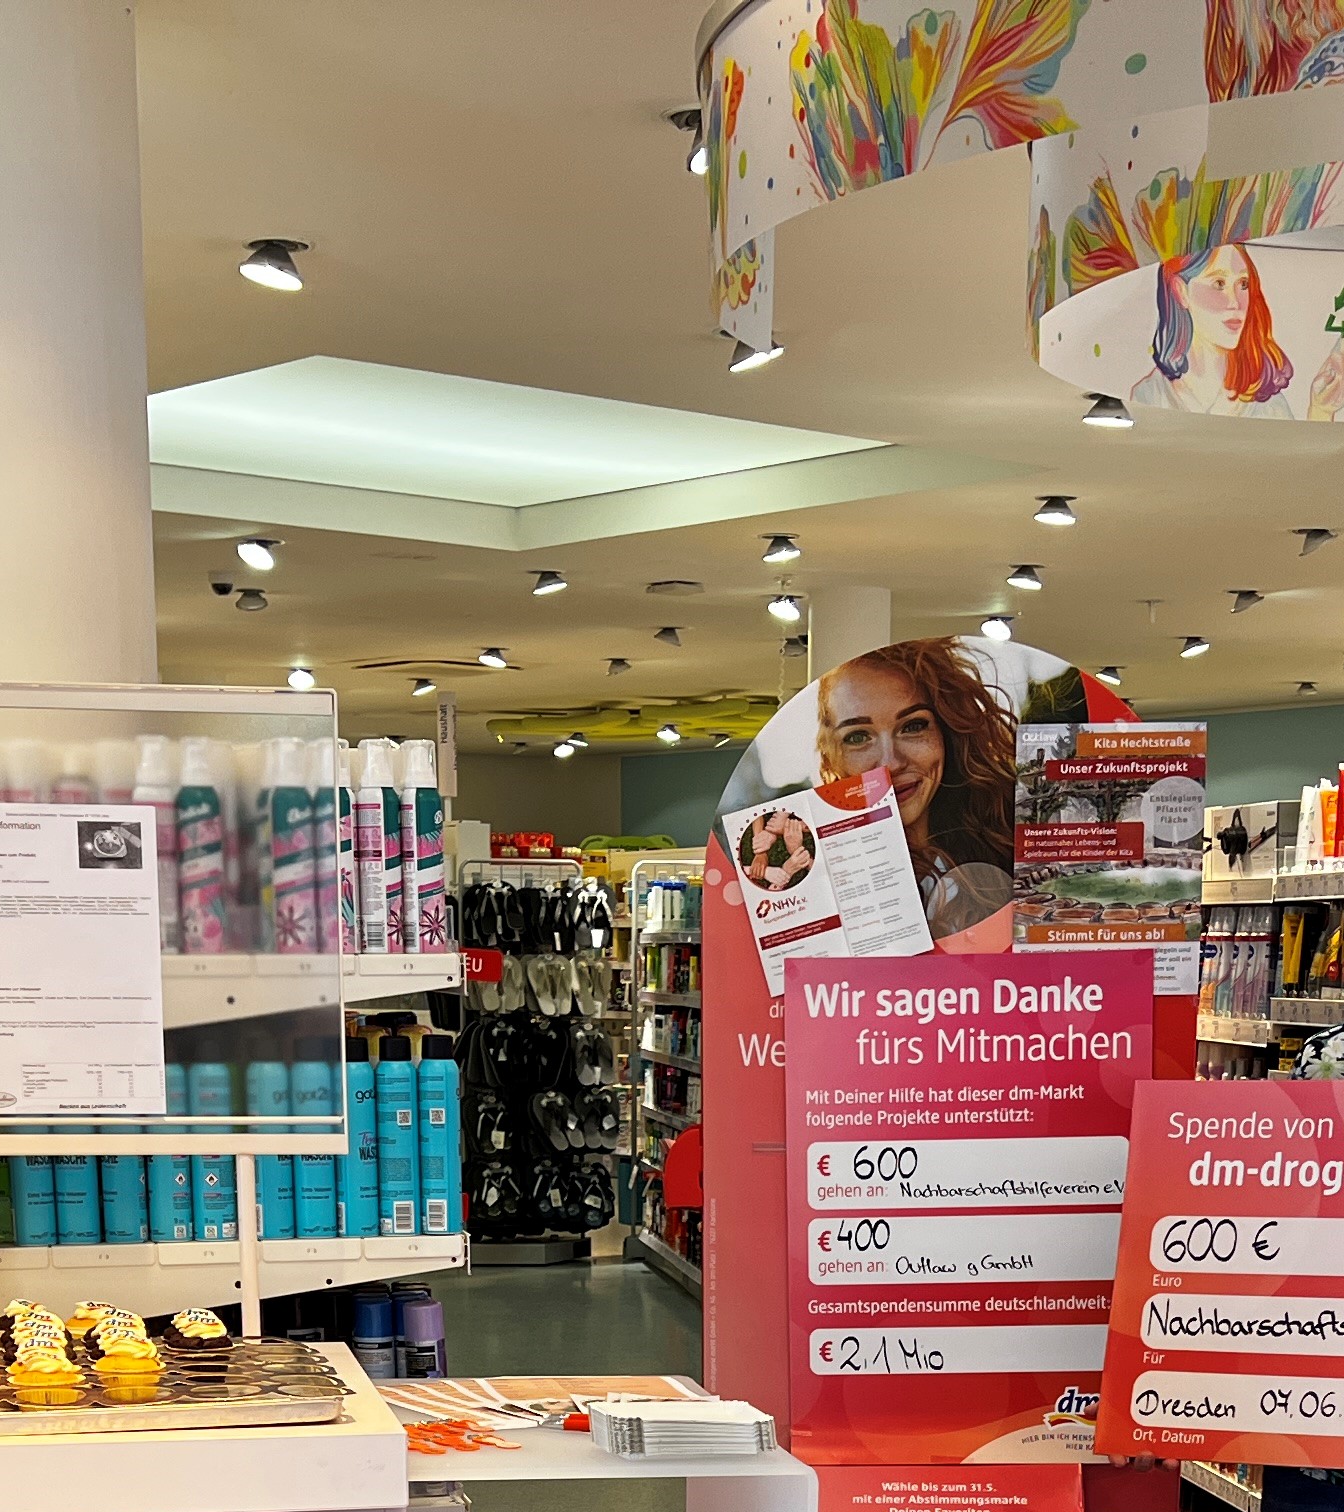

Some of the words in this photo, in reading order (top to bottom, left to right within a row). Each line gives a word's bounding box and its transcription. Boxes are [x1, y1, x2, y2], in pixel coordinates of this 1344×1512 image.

[1094, 737, 1118, 750] Kita
[1120, 736, 1191, 750] Hechtstraße
[1060, 763, 1093, 775] Unser
[1096, 761, 1189, 777] Zukunftsprojekt
[1047, 929, 1094, 942] Stimmt
[1097, 928, 1116, 941] für
[1119, 930, 1142, 941] uns
[1145, 928, 1166, 941] ab!
[804, 981, 861, 1018] Wir
[876, 983, 980, 1024] sagen
[994, 976, 1104, 1014] Danke
[856, 1028, 924, 1066] fürs
[937, 1024, 1132, 1064] Mitmachen
[805, 1088, 830, 1105] Mit
[834, 1087, 884, 1105] Deiner
[889, 1085, 924, 1104] Hilfe
[928, 1086, 955, 1103] hat
[957, 1085, 1005, 1102] dieser
[1009, 1084, 1085, 1102] dm-Markt
[805, 1110, 873, 1130] folgende
[877, 1108, 940, 1129] Projekte
[944, 1107, 1035, 1124] unterstützt:
[1168, 1111, 1274, 1143] Spende
[1283, 1117, 1334, 1140] von
[817, 1155, 831, 1177] €
[853, 1145, 918, 1182] 600
[817, 1185, 862, 1201] gehen
[866, 1184, 889, 1198] an:
[900, 1179, 1100, 1200] Nachbarschaftshilfeverein
[818, 1230, 832, 1253] €
[837, 1218, 891, 1252] 400
[1161, 1218, 1238, 1262] 600
[1251, 1220, 1281, 1260] €
[818, 1259, 863, 1277] gehen
[866, 1258, 889, 1274] an:
[895, 1255, 957, 1276] Outlaw
[1152, 1275, 1183, 1289] Euro
[808, 1297, 981, 1317] Gesamtspendensumme
[984, 1294, 1111, 1313] deutschlandweit:
[819, 1341, 834, 1362] €
[898, 1338, 944, 1371] Mio
[1143, 1351, 1165, 1365] Für
[1135, 1389, 1237, 1420] Dresden
[1133, 1429, 1157, 1444] Ort,
[1161, 1430, 1205, 1446] Datum
[881, 1481, 919, 1492] Wähle
[875, 1495, 906, 1505] einer
[909, 1494, 1029, 1507] Abstimmungsmarke
